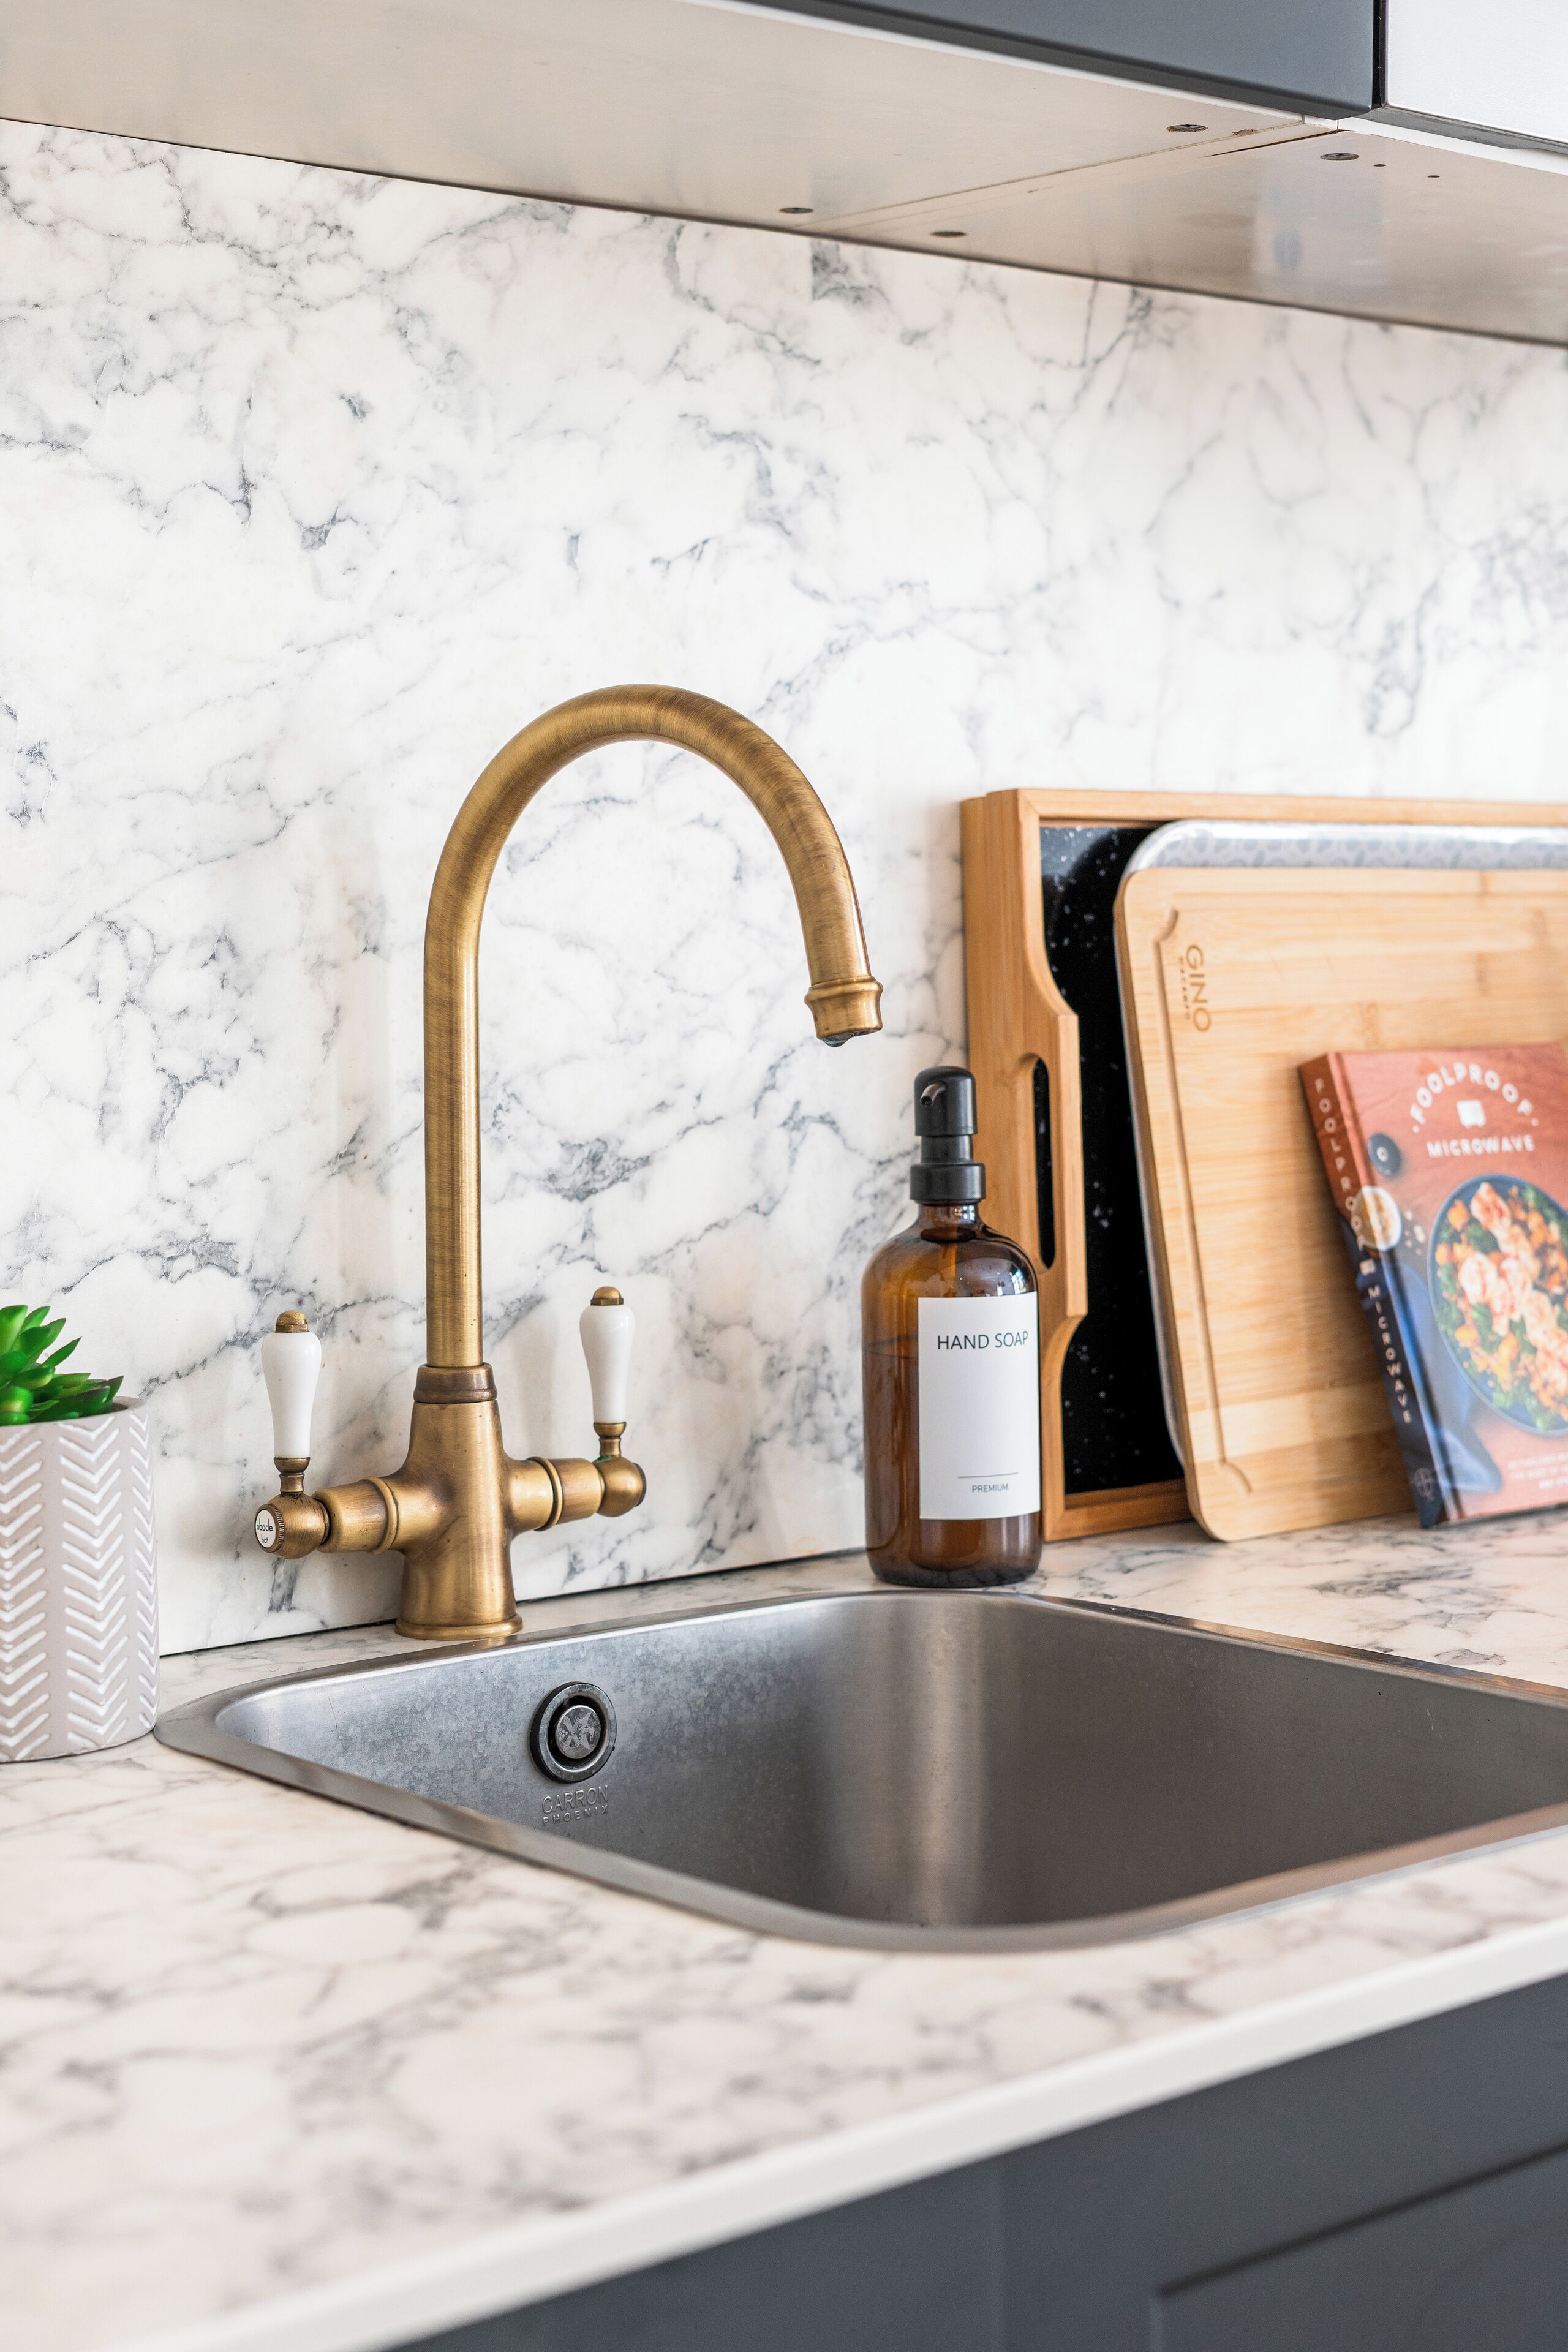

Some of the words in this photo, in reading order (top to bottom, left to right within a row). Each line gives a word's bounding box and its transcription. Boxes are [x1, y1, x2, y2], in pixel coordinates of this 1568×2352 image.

[1186, 944, 1212, 1031] GINO
[1410, 1061, 1533, 1125] FOOLPROOF
[1427, 1134, 1534, 1158] MICROWAVE
[938, 1335, 989, 1349] HAND
[995, 1330, 1028, 1348] SOAP
[1368, 1284, 1411, 1423] MICROWAVE
[972, 1483, 1008, 1493] PREMIUM
[542, 1784, 608, 1814] CARRON
[542, 1804, 608, 1826] PHOENIX
